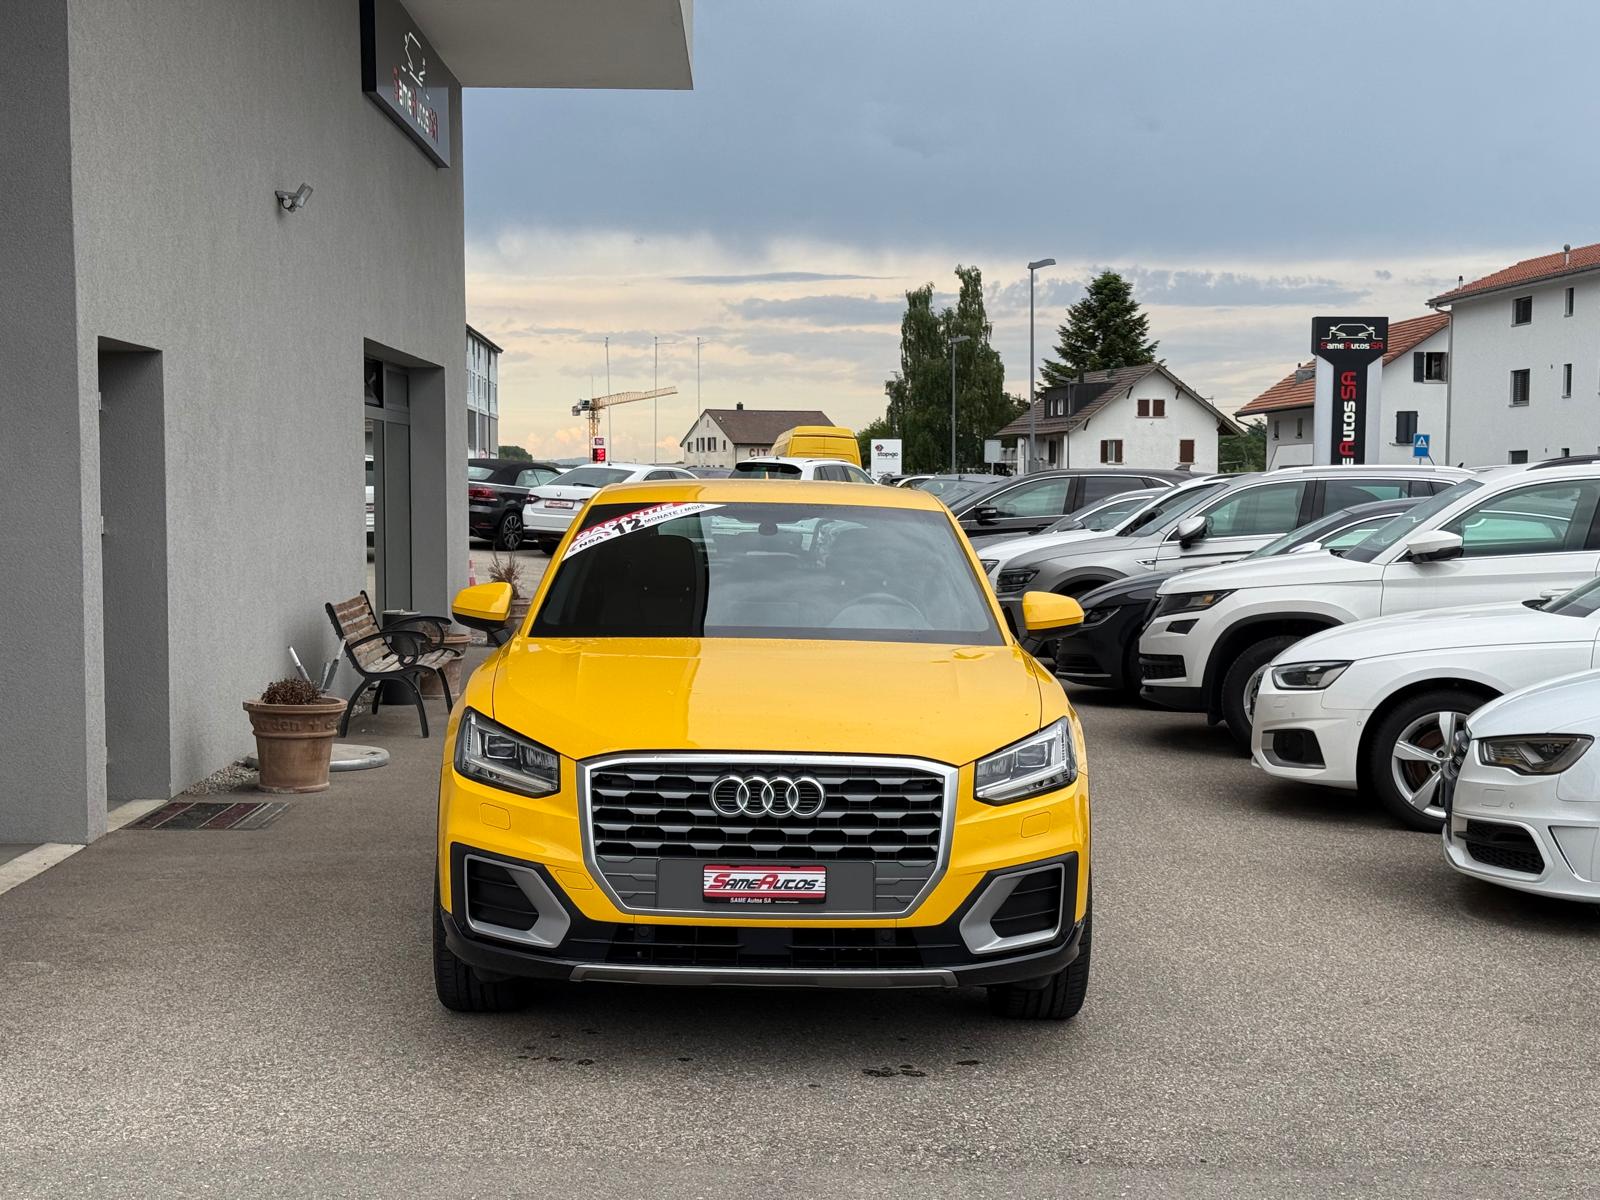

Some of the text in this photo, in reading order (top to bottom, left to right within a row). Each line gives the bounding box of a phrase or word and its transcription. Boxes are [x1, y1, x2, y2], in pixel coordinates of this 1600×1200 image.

[644, 509, 679, 524] MONATE
[684, 504, 706, 512] MOIS
[612, 518, 645, 535] 12
